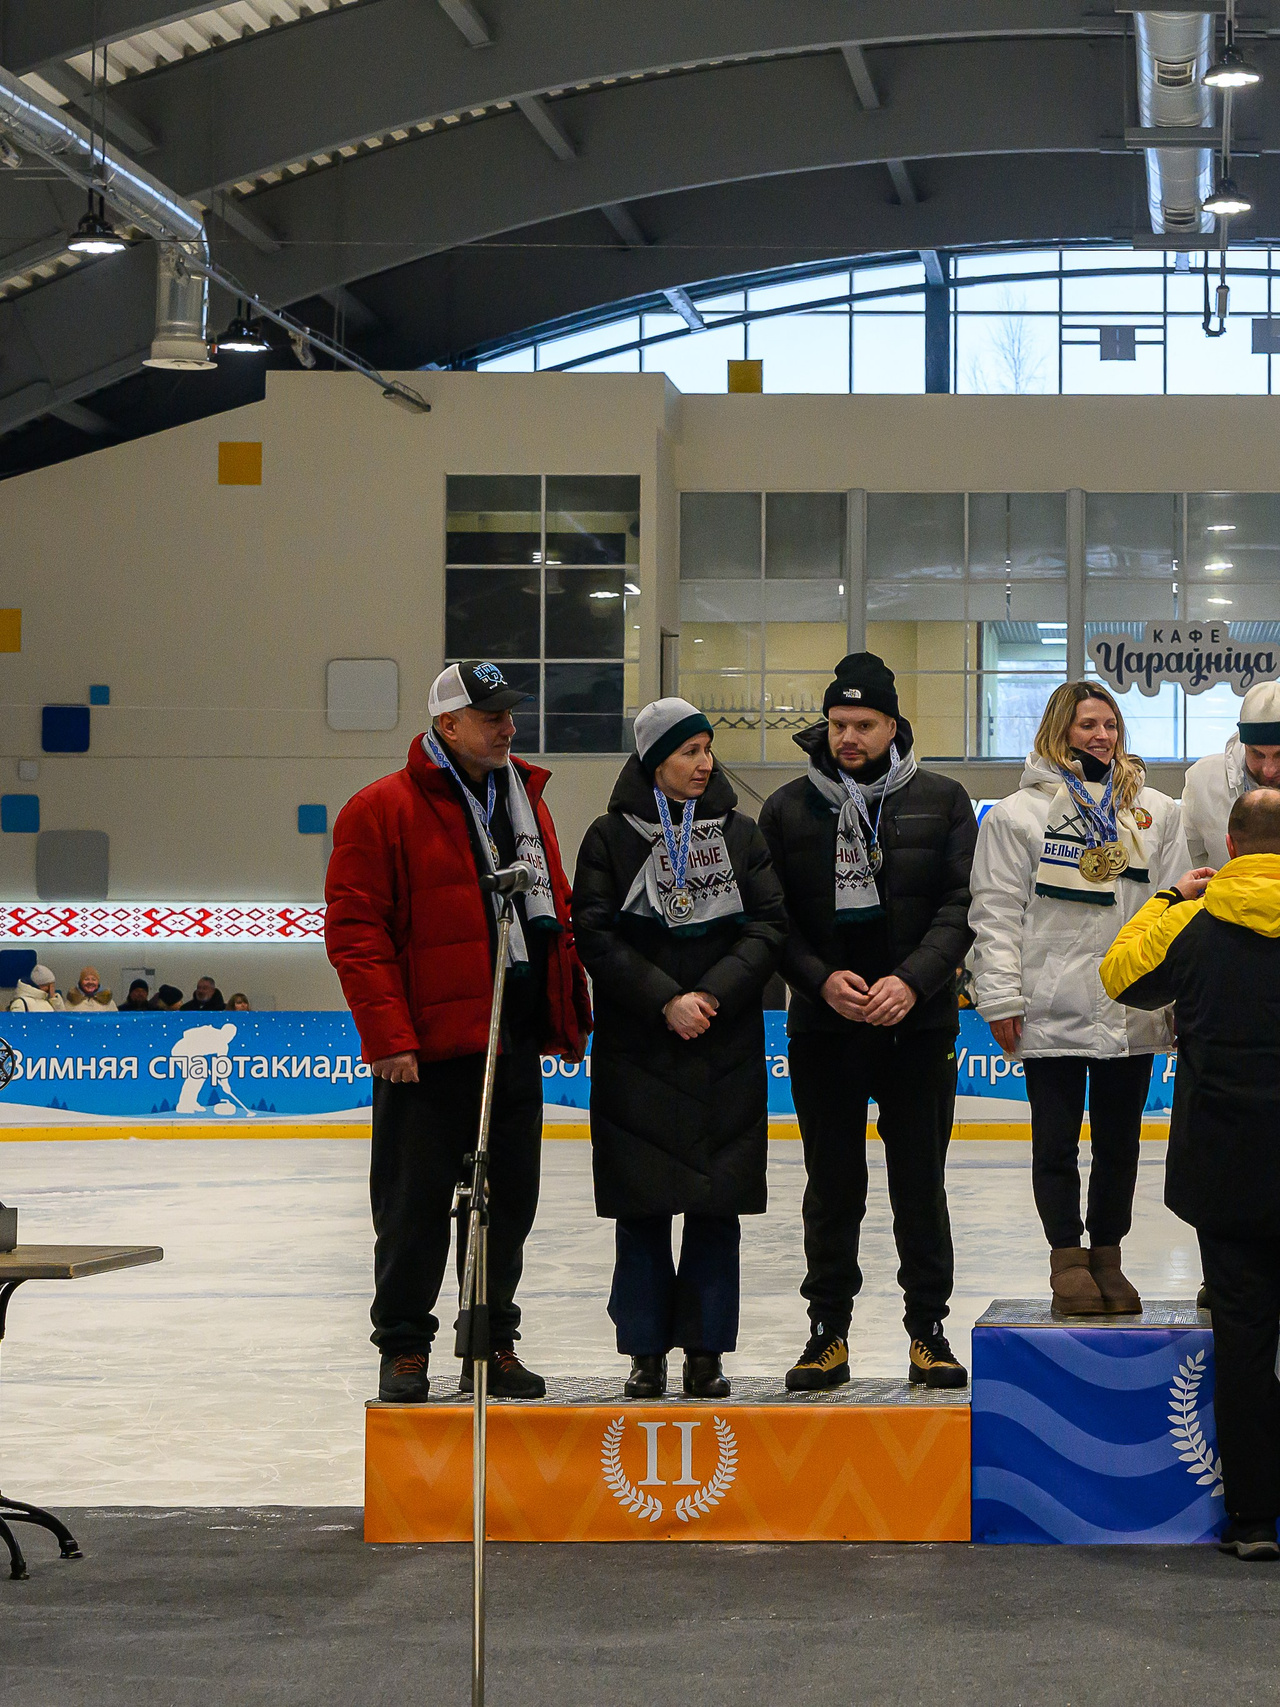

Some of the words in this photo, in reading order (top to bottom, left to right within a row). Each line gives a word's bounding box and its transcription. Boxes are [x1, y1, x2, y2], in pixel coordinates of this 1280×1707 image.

[1153, 629, 1220, 643] КАФЕ
[148, 1055, 372, 1087] спартакиада
[637, 1421, 702, 1486] II
